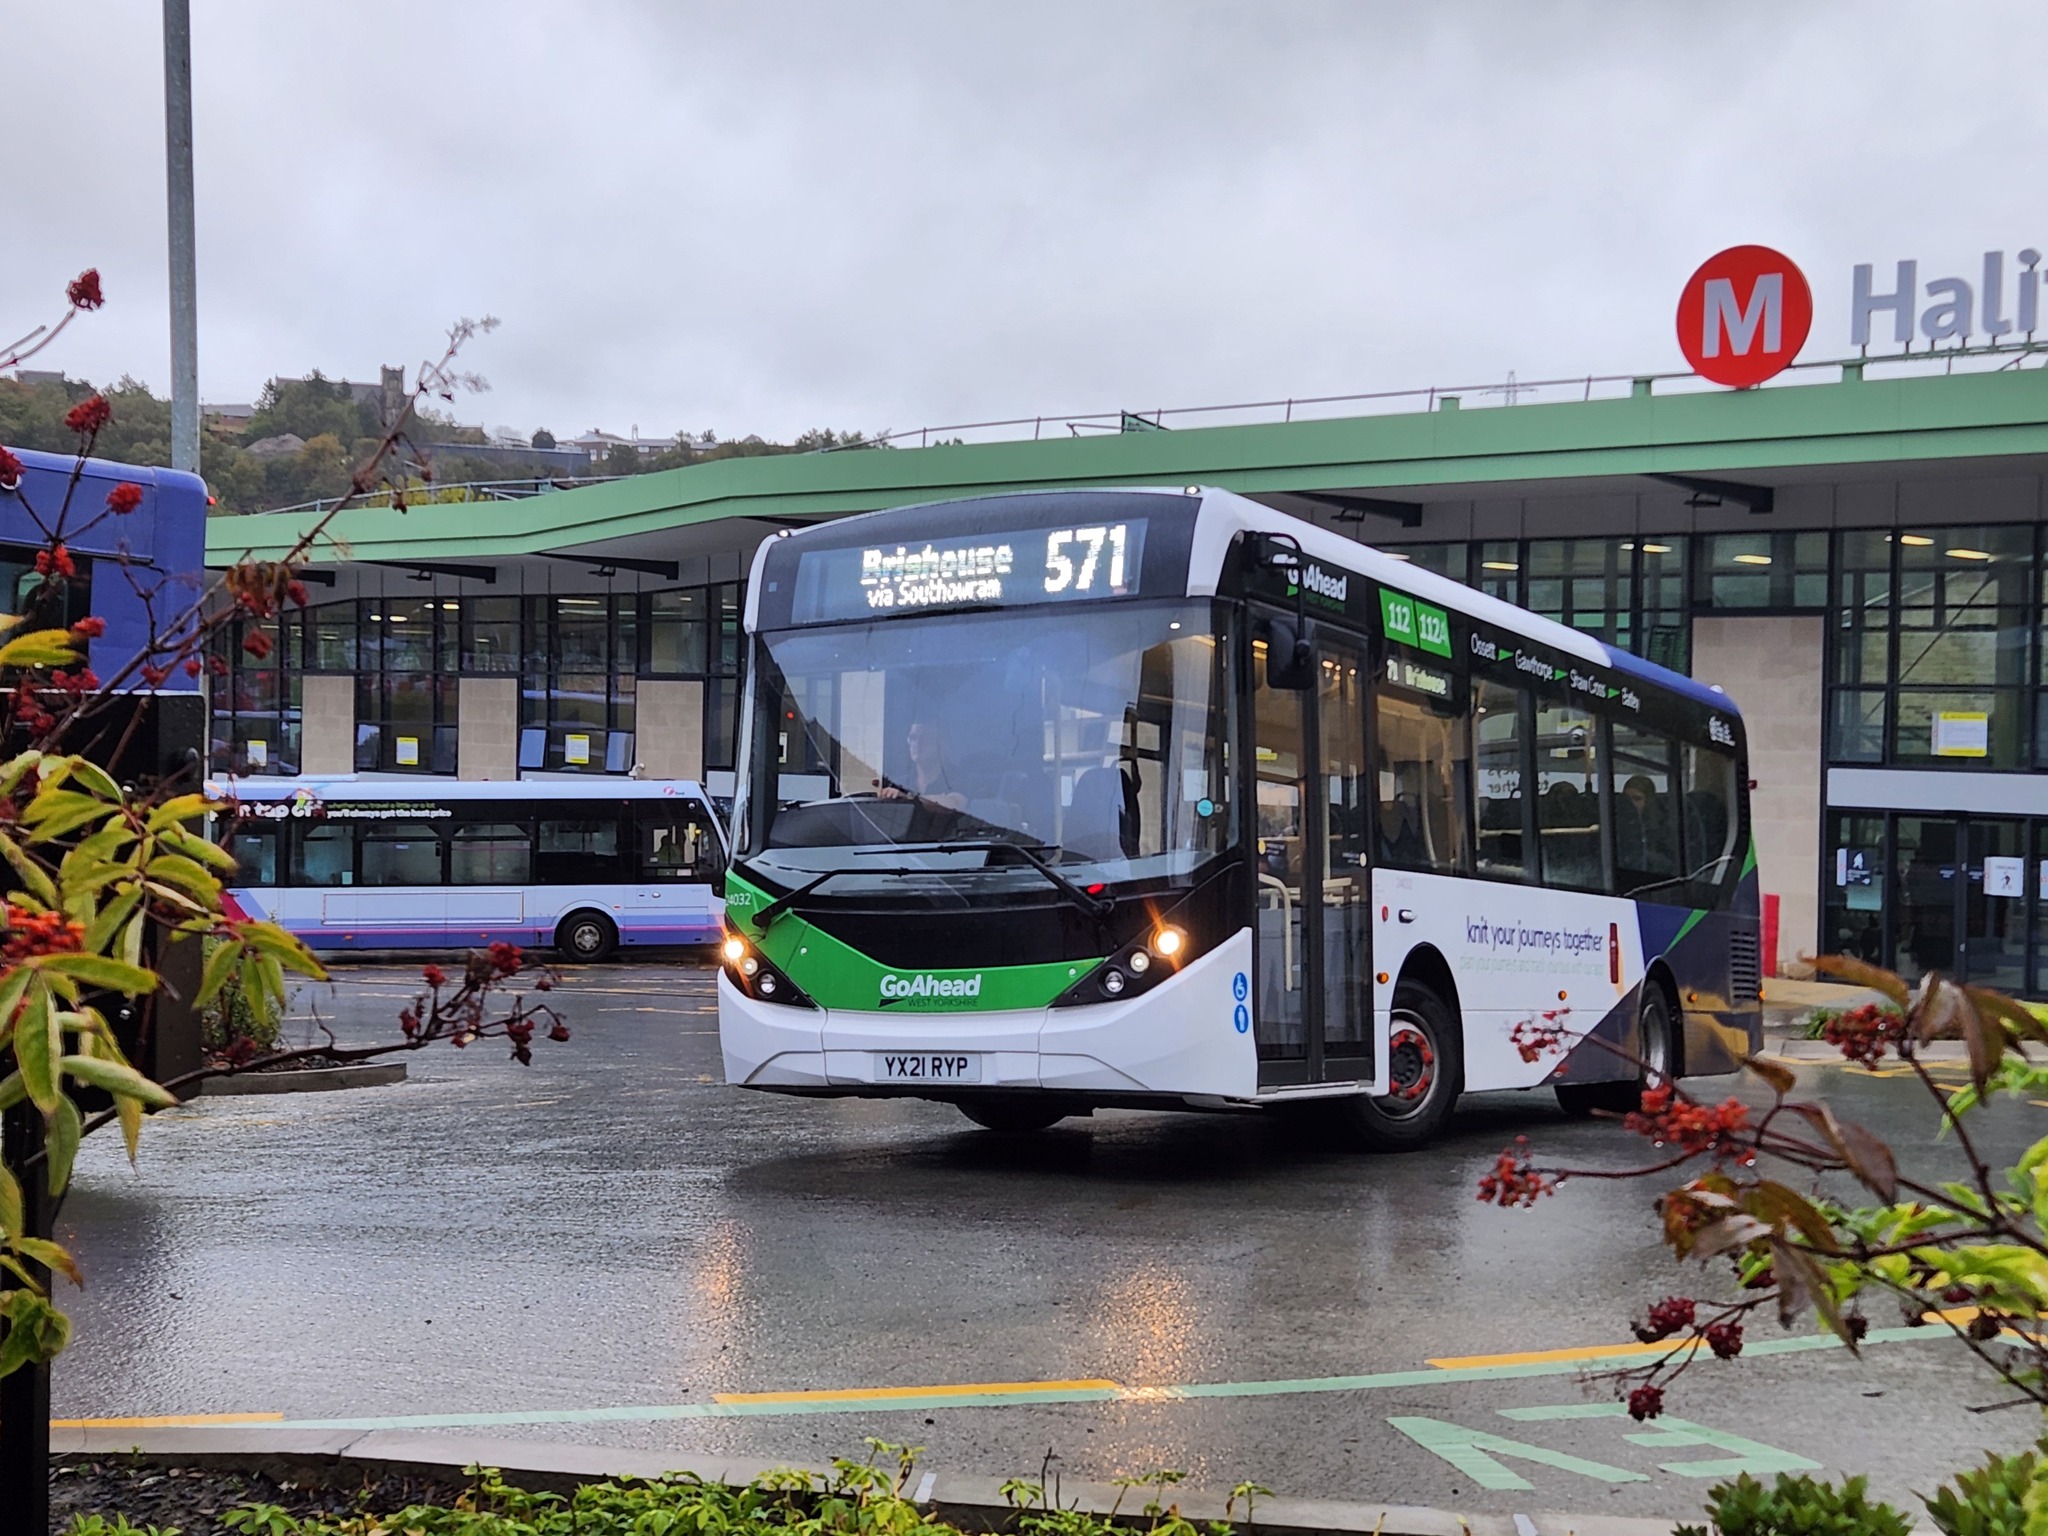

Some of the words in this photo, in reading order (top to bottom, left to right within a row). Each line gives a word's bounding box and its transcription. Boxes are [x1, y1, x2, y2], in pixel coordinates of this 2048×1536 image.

[1702, 272, 1783, 358] M
[1851, 248, 2048, 346] Hali
[860, 543, 1014, 585] Brighouse
[1044, 525, 1127, 592] 571
[868, 583, 894, 607] via
[1389, 602, 1410, 634] 112
[1420, 613, 1449, 647] 112A
[1466, 915, 1489, 945] knit
[1491, 924, 1515, 951] your
[1516, 919, 1561, 955] journeys
[1562, 927, 1604, 956] together
[880, 973, 982, 997] GoAhead
[908, 998, 931, 1007] WEST
[932, 997, 978, 1007] YORKSHIRE
[884, 1056, 926, 1077] YX21
[931, 1056, 968, 1077] RYP
